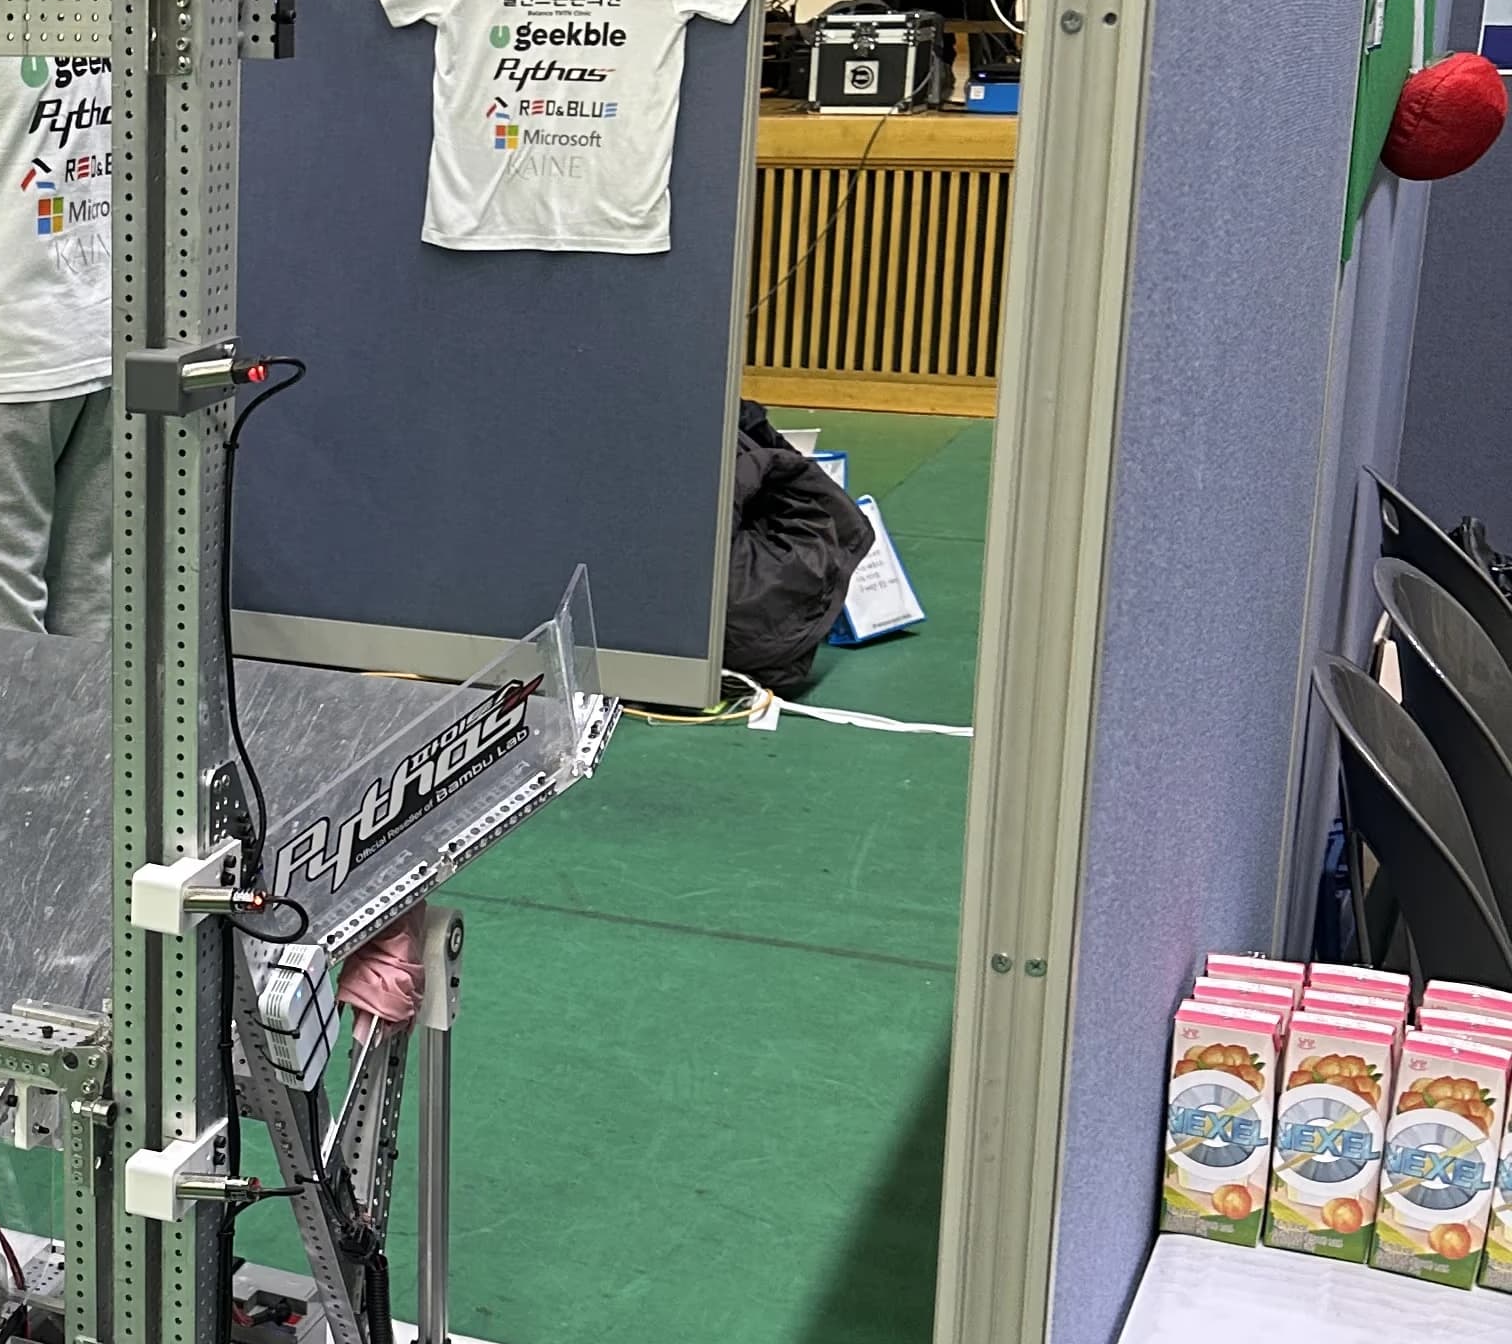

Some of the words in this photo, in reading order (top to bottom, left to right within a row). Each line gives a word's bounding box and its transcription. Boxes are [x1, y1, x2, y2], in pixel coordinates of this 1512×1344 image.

[514, 21, 627, 52] geekble
[523, 128, 602, 147] Microsoft
[69, 199, 110, 223] Micro
[355, 836, 386, 863] Official
[388, 808, 423, 839] Reseller
[424, 798, 434, 812] of
[436, 755, 493, 801] Bambu
[496, 729, 528, 757] Lab
